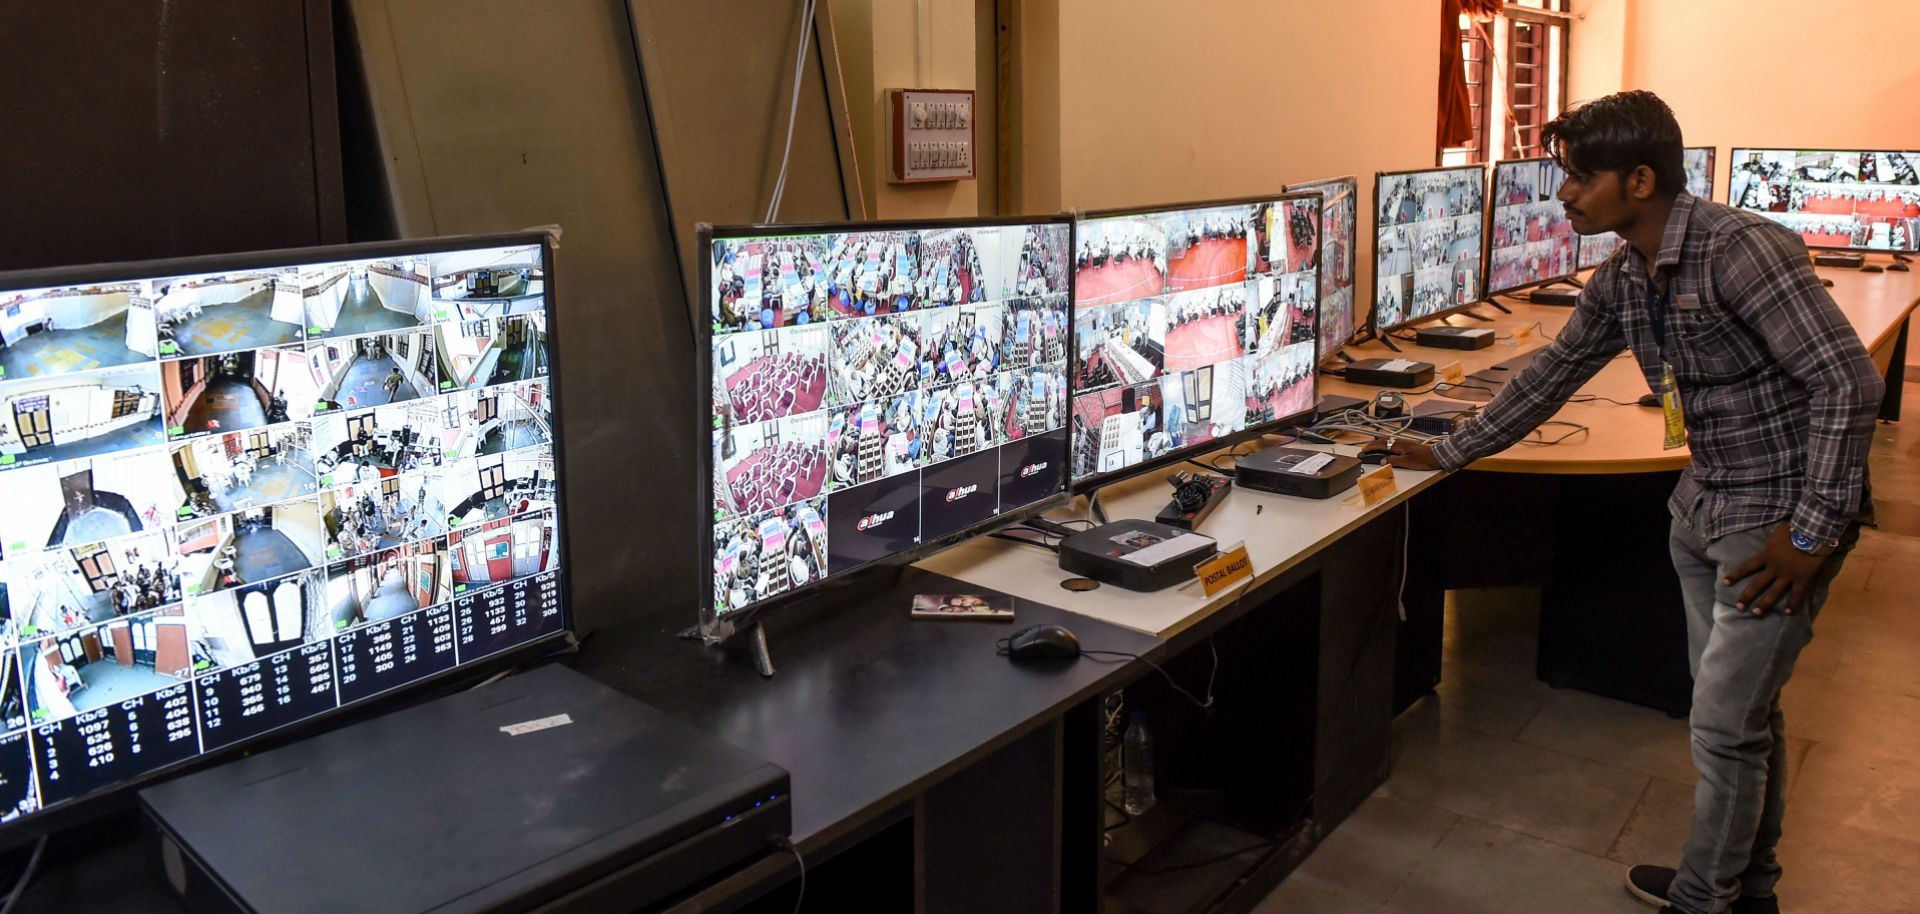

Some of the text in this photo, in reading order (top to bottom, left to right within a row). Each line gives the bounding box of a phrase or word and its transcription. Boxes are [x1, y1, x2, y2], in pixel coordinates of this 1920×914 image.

[537, 366, 548, 374] 12
[304, 482, 316, 490] 16
[1204, 557, 1248, 586] POSTAL BALLOT
[459, 597, 475, 608] CH
[483, 588, 504, 600] Kb/S
[513, 580, 527, 590] CH
[535, 572, 555, 583] Kb/S
[489, 597, 504, 607] 932
[514, 591, 525, 599] 29
[541, 581, 556, 590] 928
[339, 633, 357, 644] CH
[366, 622, 391, 636] Kb/S
[401, 614, 417, 625] CH
[426, 605, 449, 617] Kb/S
[461, 617, 472, 625] 26
[485, 607, 505, 618] 1133
[515, 600, 525, 608] 30
[462, 626, 472, 635] 27
[515, 608, 526, 617] 31
[341, 644, 353, 654] 17
[402, 625, 413, 634] 21
[428, 615, 450, 626] 1133
[342, 624, 450, 663] 18 1149 22 409
[463, 635, 473, 644] 28
[491, 625, 506, 635] 299
[516, 617, 527, 626] 32
[200, 675, 221, 687] CH
[232, 663, 260, 677] Kb/S
[272, 653, 290, 664] CH
[301, 642, 328, 655] Kb/S
[343, 664, 355, 673] 19
[404, 644, 416, 653] 23
[434, 633, 451, 644] 603
[174, 668, 189, 679] 27
[206, 687, 214, 696] 9
[274, 665, 288, 674] 13
[344, 674, 356, 684] 20
[376, 662, 394, 672] 300
[405, 654, 416, 663] 24
[204, 697, 218, 707] 10
[241, 684, 262, 696] 940
[275, 675, 288, 685] 14
[205, 708, 219, 718] 11
[276, 685, 290, 695] 15
[7, 716, 25, 728] 26
[39, 685, 186, 736] CH Kb/S CH Kb/S
[46, 737, 54, 746] 1
[79, 720, 109, 736] 1097
[164, 696, 187, 708] 402
[207, 718, 221, 729] 12
[277, 696, 291, 705] 16
[47, 748, 56, 757] 2
[130, 723, 138, 732] 6
[165, 707, 188, 720] 404
[131, 733, 139, 742] 7
[50, 770, 59, 780] 4
[89, 754, 114, 767] 410
